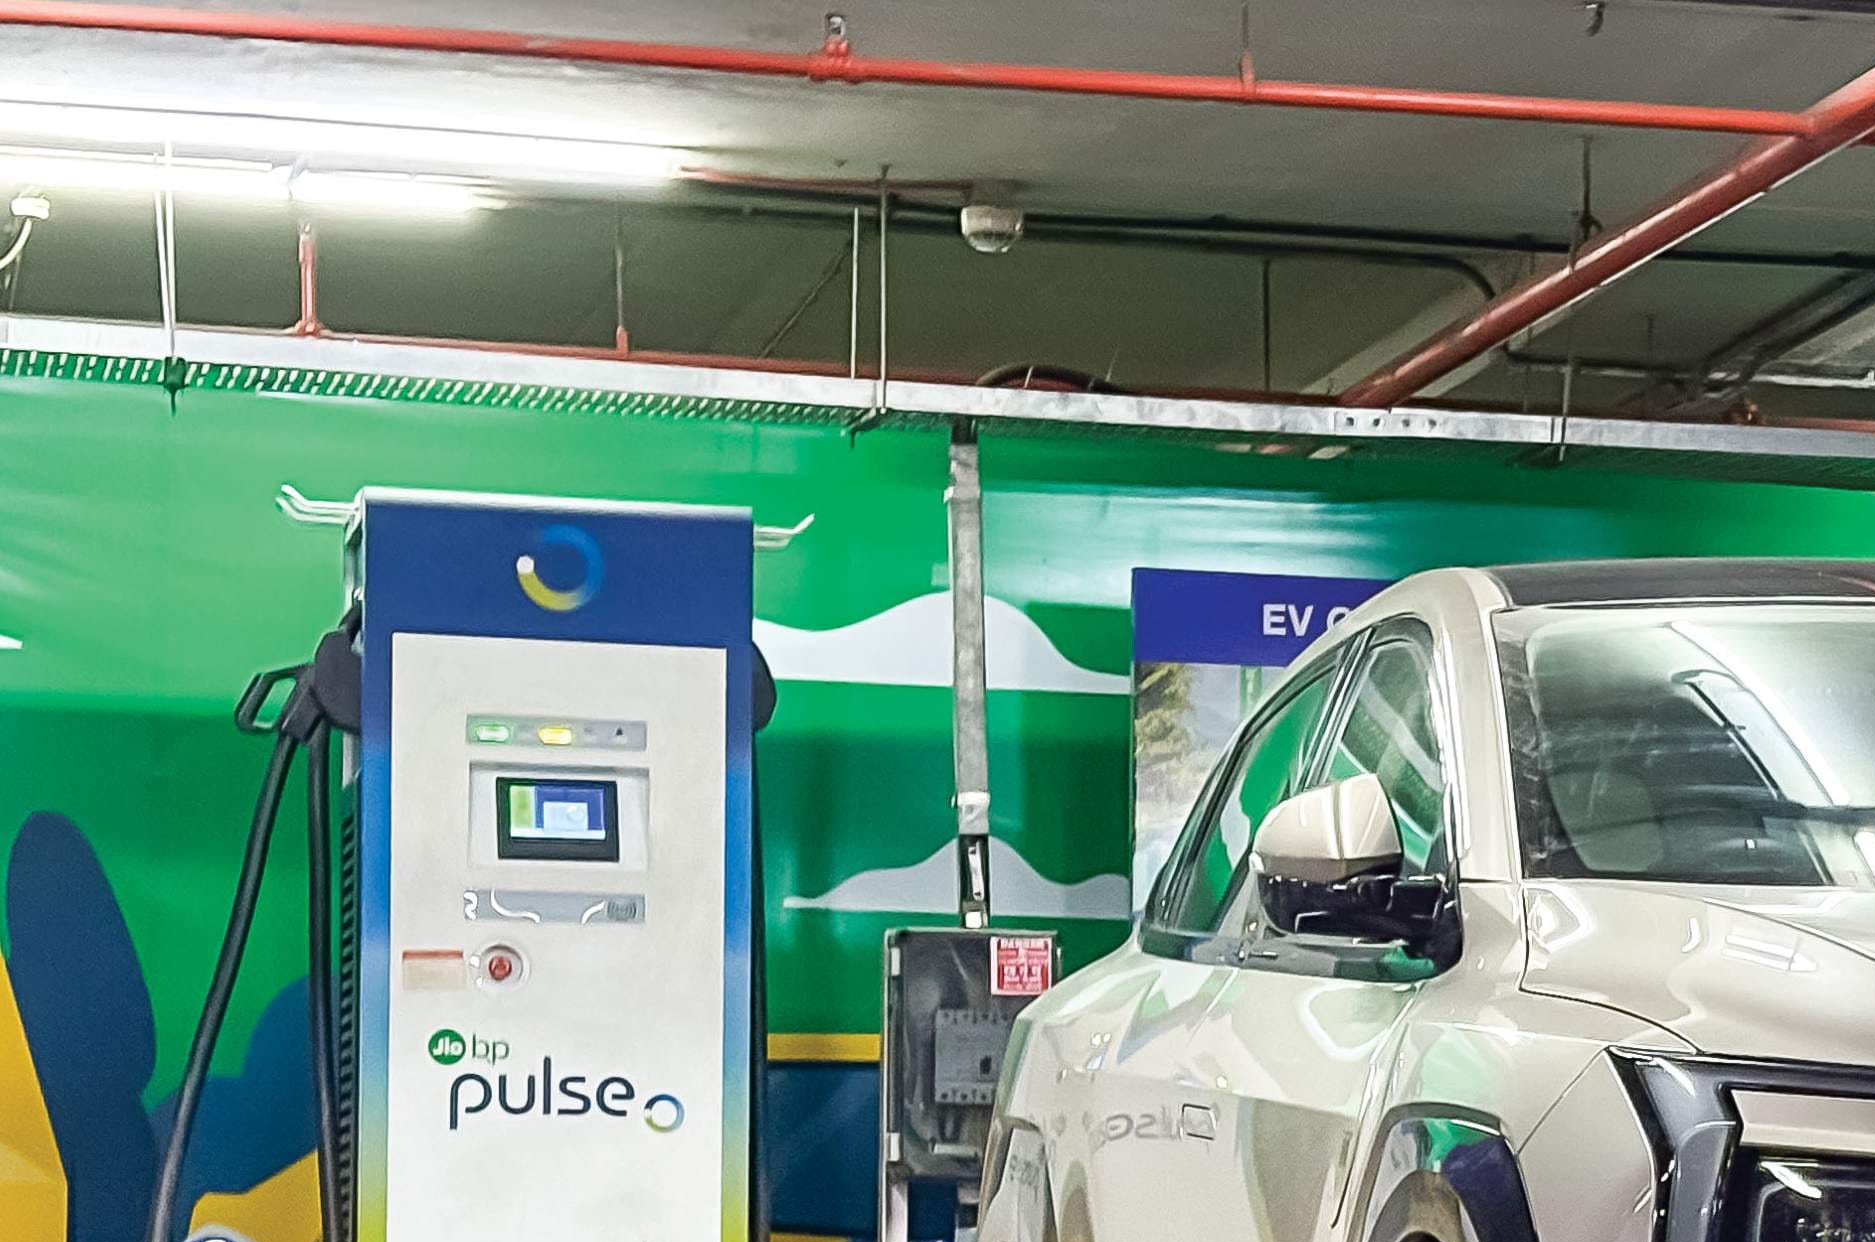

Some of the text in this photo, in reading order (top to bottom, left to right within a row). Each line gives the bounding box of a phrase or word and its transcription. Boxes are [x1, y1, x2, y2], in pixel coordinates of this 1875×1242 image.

[1263, 603, 1313, 637] EV
[472, 1033, 510, 1065] bp
[449, 1055, 635, 1130] pulse
